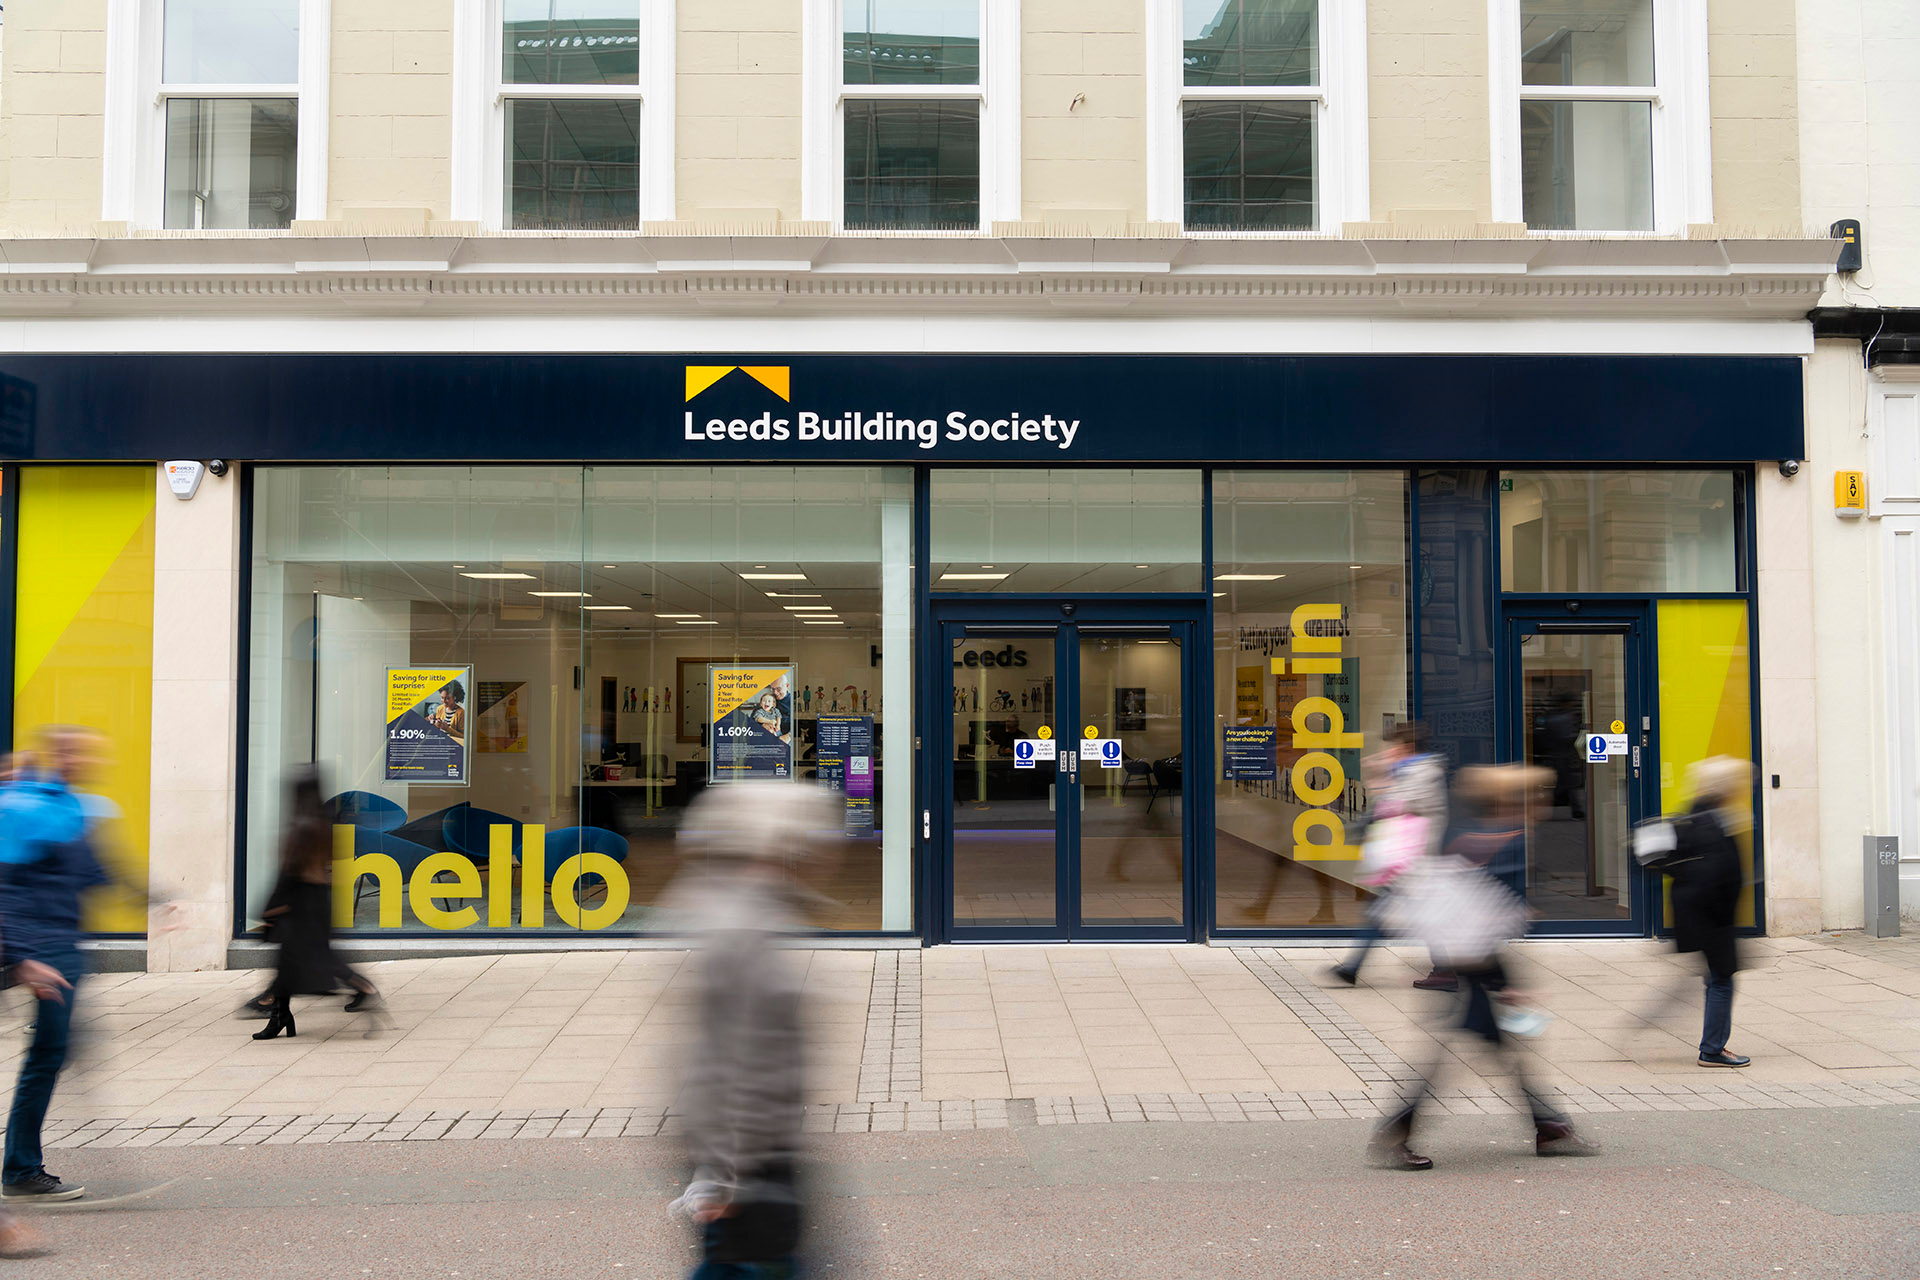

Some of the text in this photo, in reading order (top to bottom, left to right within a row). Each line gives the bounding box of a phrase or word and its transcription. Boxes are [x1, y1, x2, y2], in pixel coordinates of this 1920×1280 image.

[685, 411, 1081, 449] Leeds Building Society
[1849, 475, 1857, 497] SAV
[1240, 623, 1268, 656] Putting
[1269, 624, 1290, 656] your
[392, 674, 417, 682] Saving
[718, 673, 742, 681] Saving
[390, 729, 425, 739] 1.90%
[718, 726, 754, 737] 1.60%
[1270, 603, 1365, 861] pop in
[1879, 851, 1897, 860] FP2
[331, 824, 630, 930] hello
